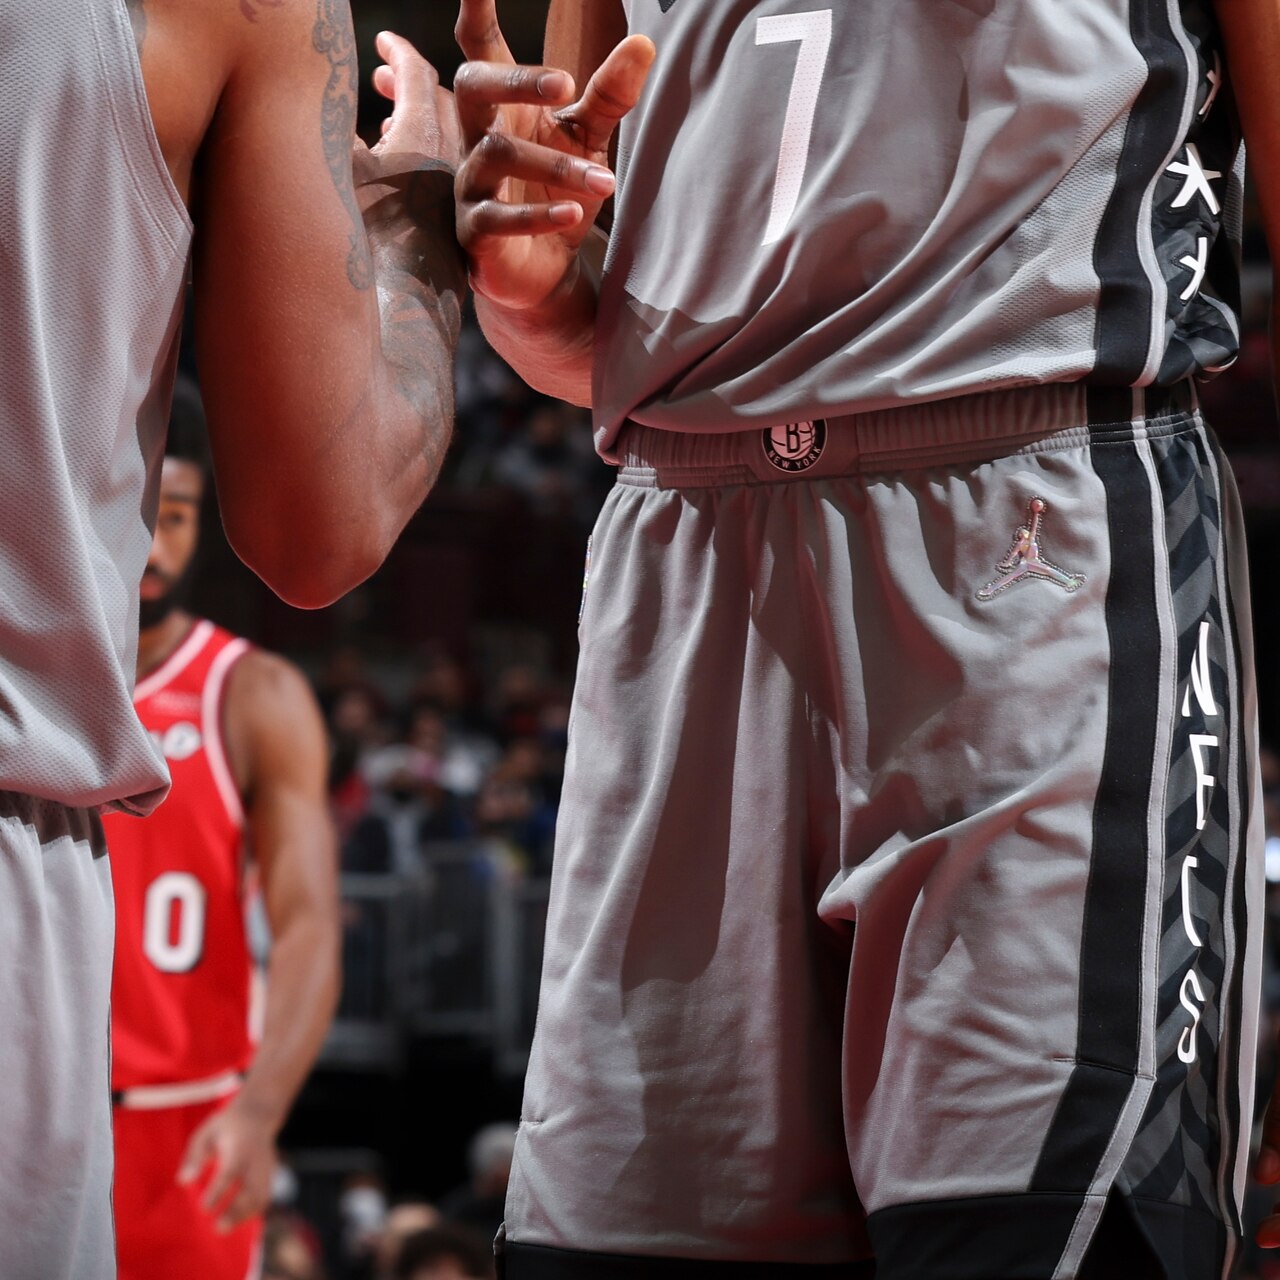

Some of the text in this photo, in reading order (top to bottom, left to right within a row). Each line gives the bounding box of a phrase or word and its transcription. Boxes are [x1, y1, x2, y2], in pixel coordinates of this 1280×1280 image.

[754, 9, 832, 247] 7
[767, 445, 822, 469] NEW YORK
